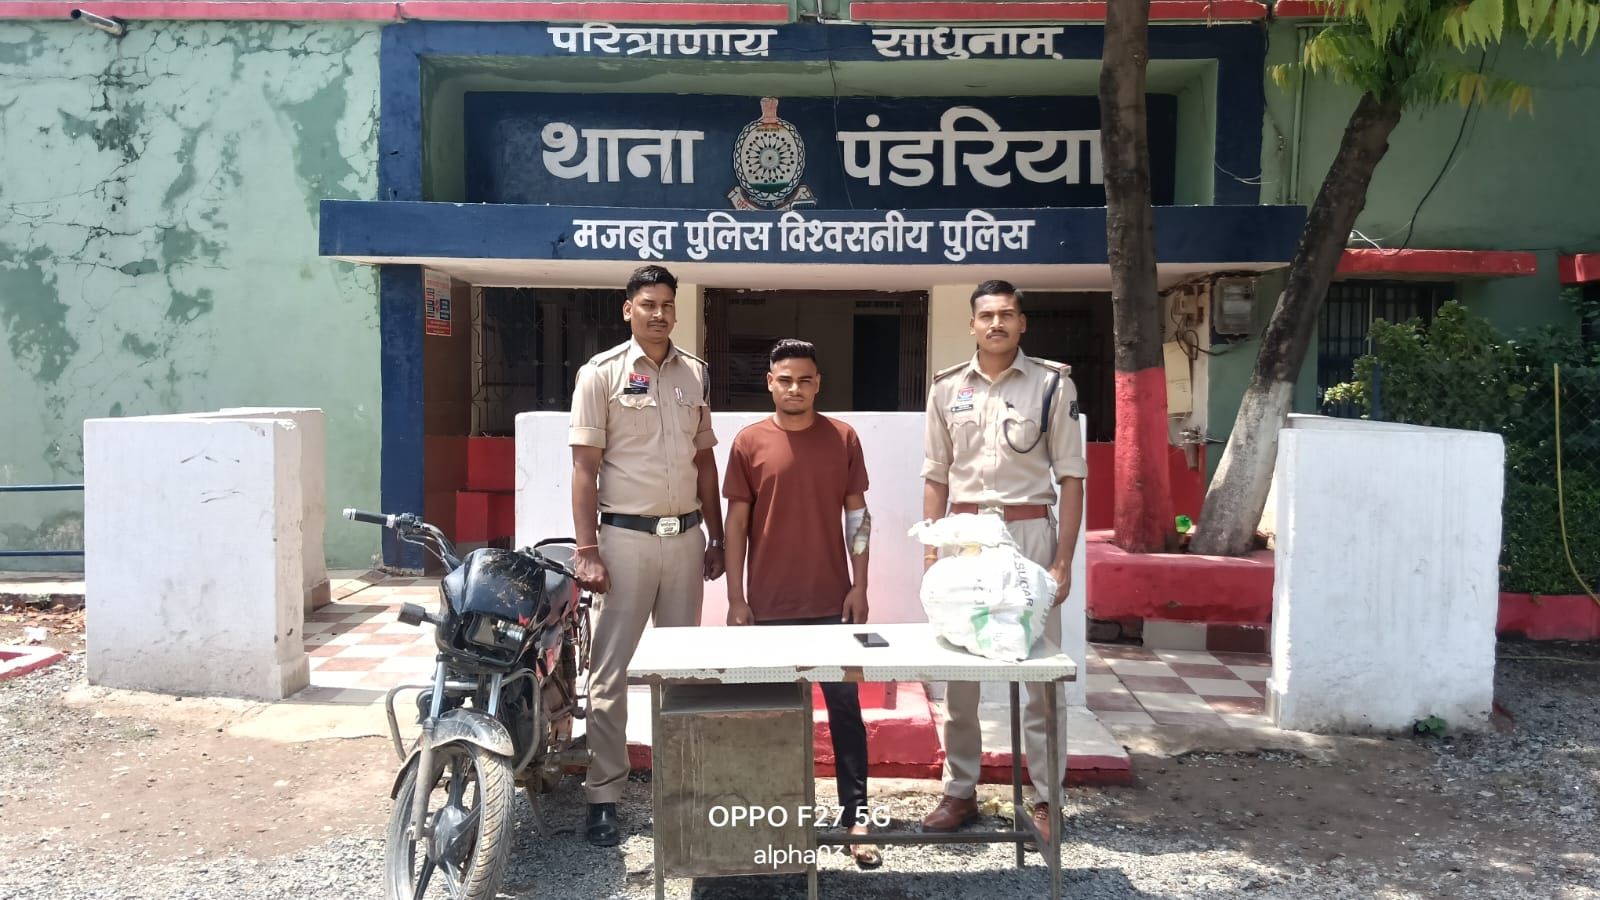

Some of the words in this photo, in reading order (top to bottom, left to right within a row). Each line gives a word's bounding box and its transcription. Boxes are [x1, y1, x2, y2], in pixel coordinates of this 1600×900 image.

[547, 22, 778, 57] परित्राणाय
[541, 122, 704, 184] थाना
[837, 106, 1104, 188] पंडरिया
[572, 219, 678, 260] मजबूत
[684, 211, 773, 260] पुलिस
[778, 210, 934, 253] विश्वसनीय
[939, 209, 1036, 262] पुलिस
[1014, 562, 1034, 607] SUGAR
